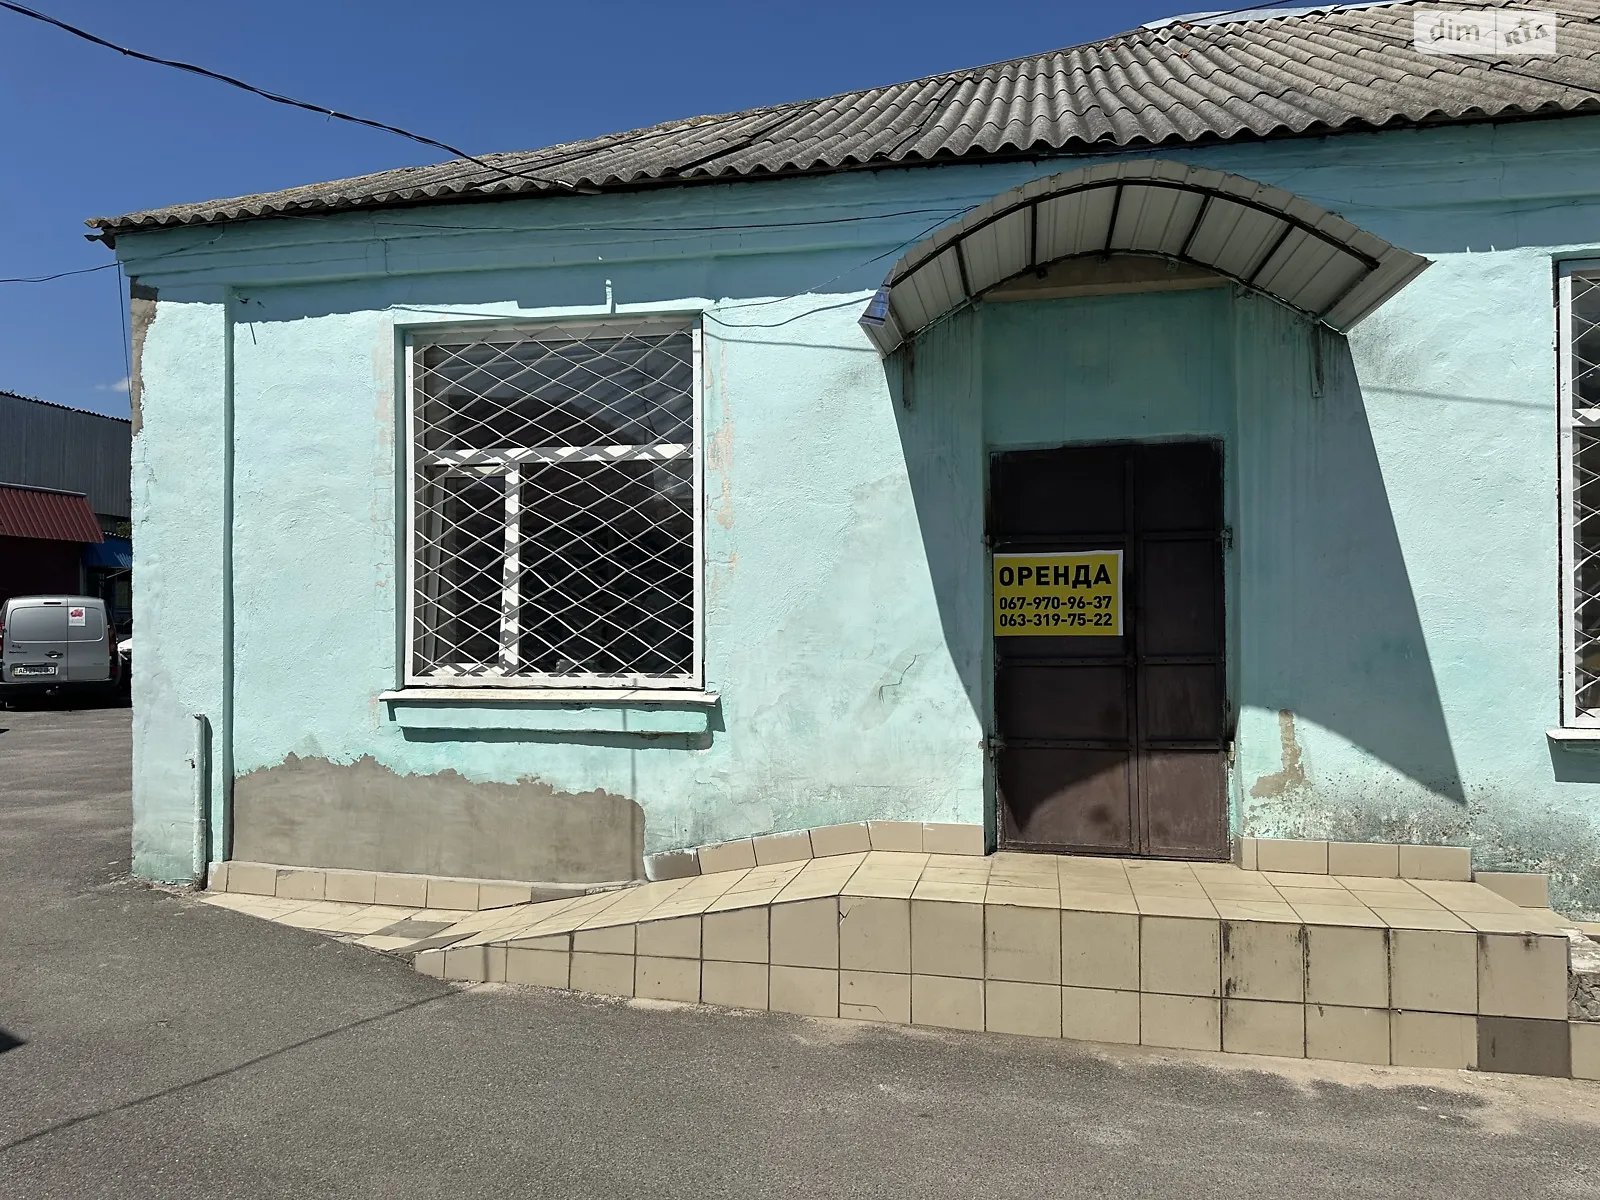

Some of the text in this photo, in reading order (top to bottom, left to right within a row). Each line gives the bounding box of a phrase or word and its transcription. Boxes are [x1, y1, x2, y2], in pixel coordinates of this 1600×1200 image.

[999, 564, 1112, 589] ОРЕНДА
[999, 596, 1112, 610] 067-970-96-37
[999, 613, 1113, 627] 063-319-75-22
